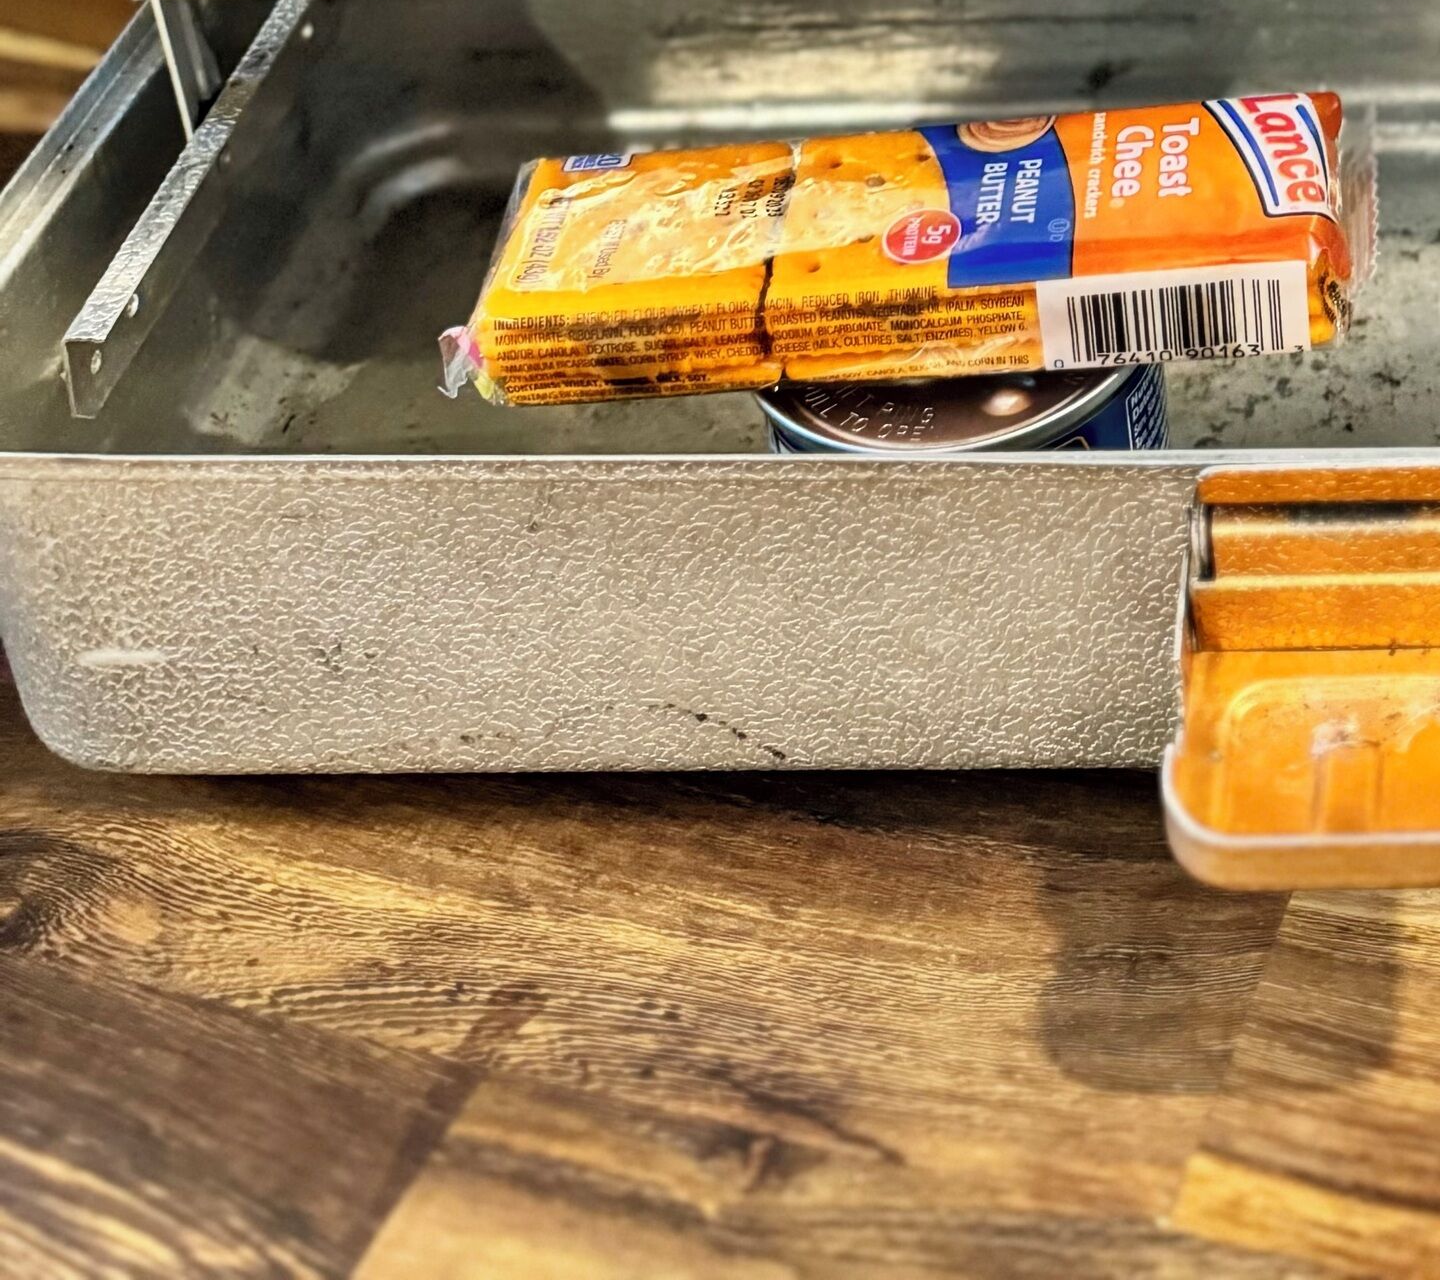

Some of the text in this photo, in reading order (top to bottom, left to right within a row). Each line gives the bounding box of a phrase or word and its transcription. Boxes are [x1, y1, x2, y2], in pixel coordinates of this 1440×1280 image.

[1111, 125, 1155, 198] Chee
[1158, 117, 1200, 198] Toast
[1238, 93, 1325, 204] Lance
[975, 162, 1008, 224] BUTTER
[1010, 158, 1043, 223] PEANUT
[1083, 167, 1102, 219] crackers
[902, 216, 921, 257] PROTEIN
[920, 224, 952, 247] 5g
[493, 313, 571, 331] INGREDIENTS:
[801, 291, 849, 307] REDUCED
[888, 285, 938, 301] THIAMINE
[690, 317, 727, 333] PEANUT
[769, 310, 818, 327] (ROASTED
[927, 299, 943, 314] OIL
[981, 294, 1025, 310] SOYBEAN
[889, 317, 962, 333] MONOCALCIUM
[966, 311, 1027, 327] PHOSPHATE,
[774, 341, 812, 355] CHEESE
[978, 322, 1018, 337] YELLOW
[1097, 344, 1173, 366] 76410
[1185, 343, 1261, 361] 90163
[968, 357, 994, 368] CORN
[1009, 354, 1031, 366] THIS
[877, 423, 931, 441] OPE
